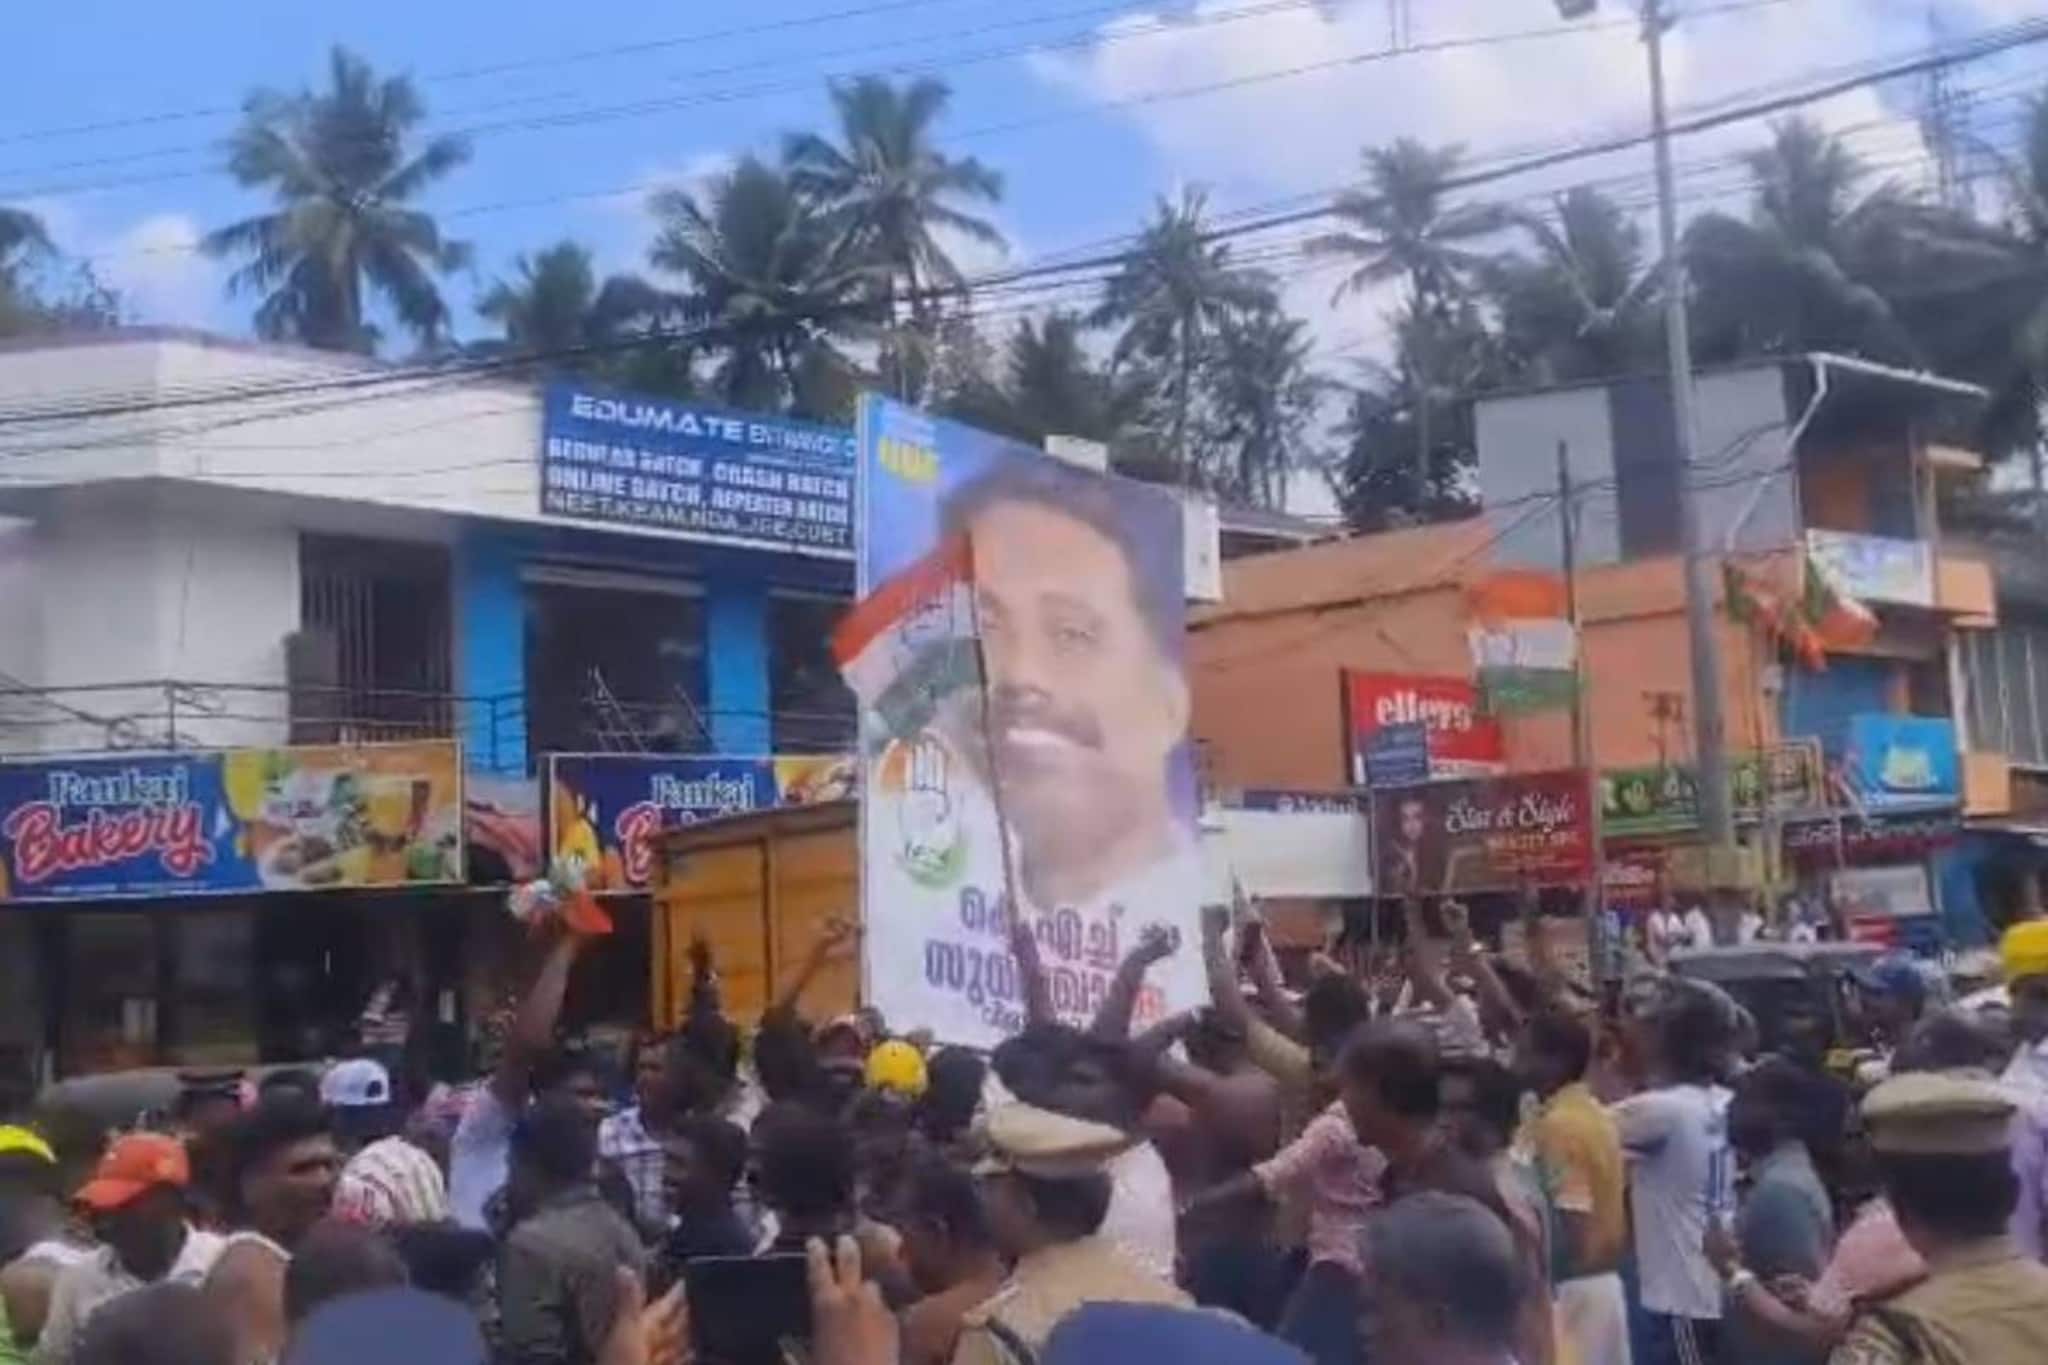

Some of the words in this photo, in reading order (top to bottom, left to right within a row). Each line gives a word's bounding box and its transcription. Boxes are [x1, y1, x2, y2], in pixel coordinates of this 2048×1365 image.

[572, 394, 744, 442] EDUMATE
[547, 464, 627, 496] ONLINE
[5, 802, 216, 883] Bakery
